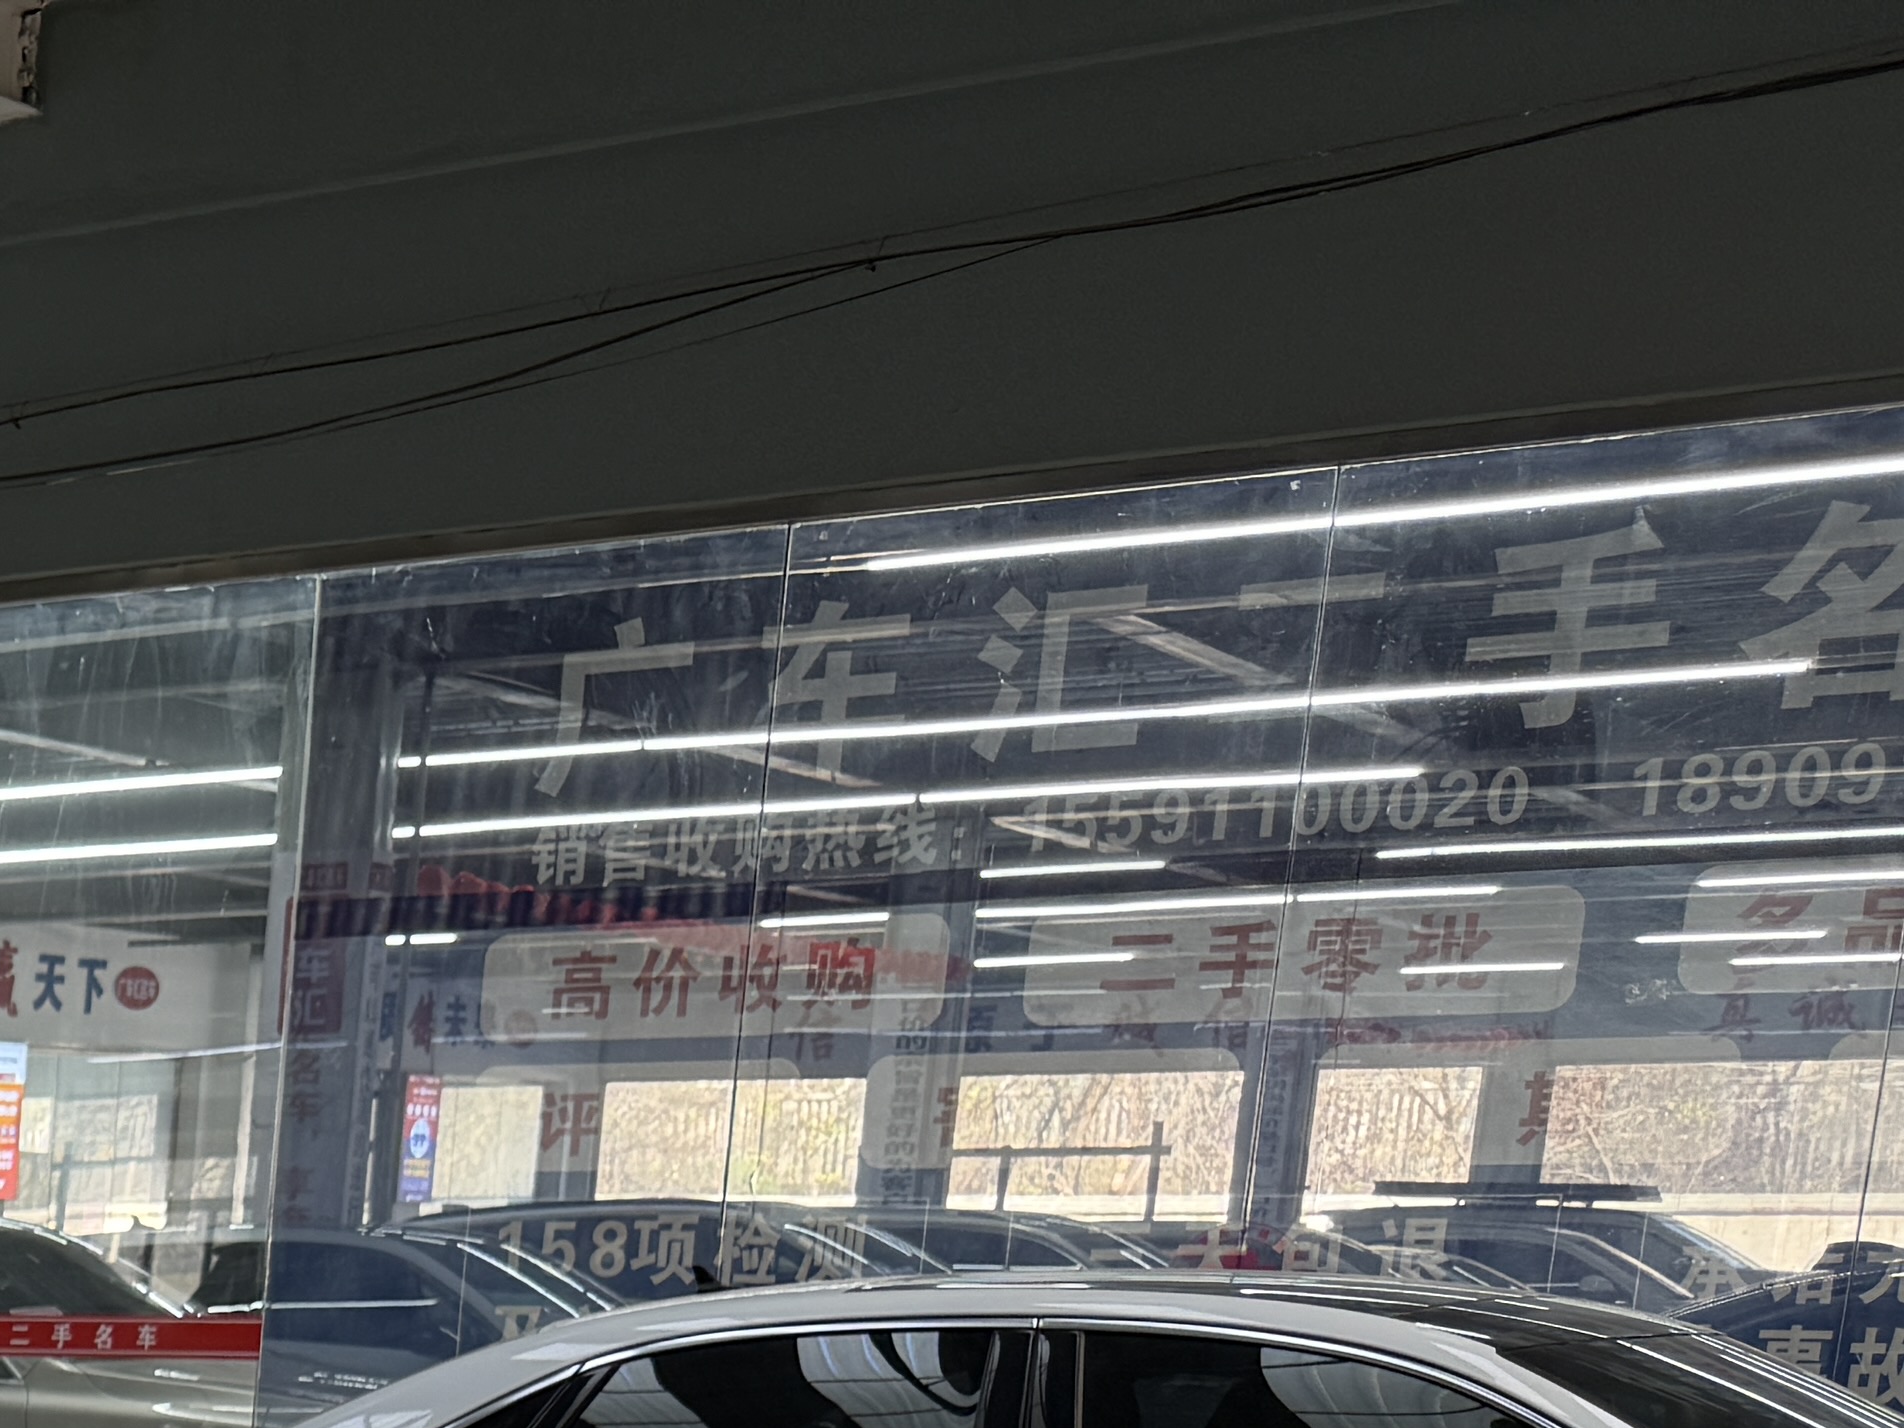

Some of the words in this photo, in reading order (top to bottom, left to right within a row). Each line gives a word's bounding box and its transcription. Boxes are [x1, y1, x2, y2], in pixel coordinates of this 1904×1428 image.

[550, 940, 877, 1022] 高价收购
[1099, 912, 1493, 999] 二手零批
